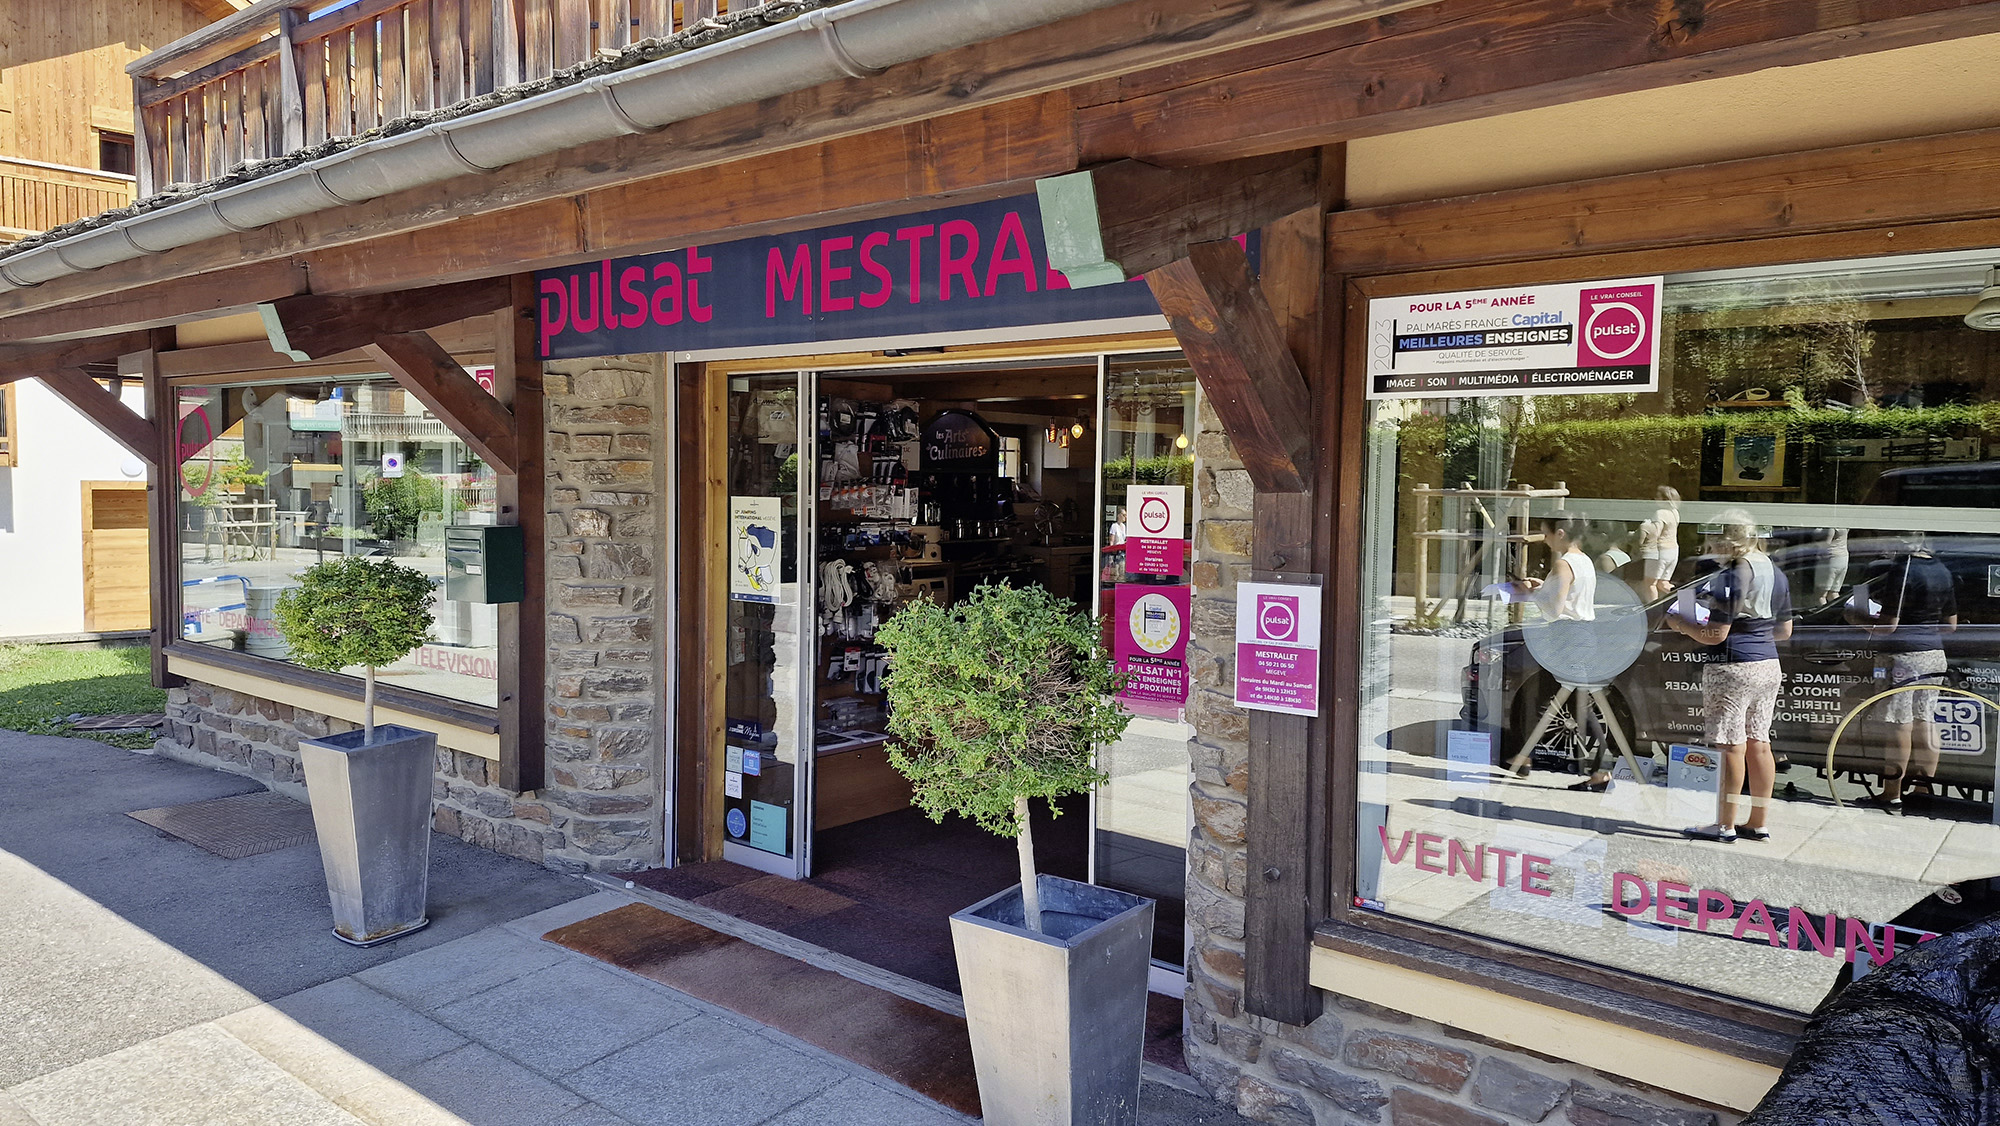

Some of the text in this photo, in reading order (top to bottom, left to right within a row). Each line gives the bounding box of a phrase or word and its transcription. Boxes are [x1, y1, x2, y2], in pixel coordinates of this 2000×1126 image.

[541, 246, 712, 356] pulsat
[1616, 291, 1643, 299] CONSEIL
[1409, 302, 1443, 313] POUR
[1446, 301, 1462, 310] LA
[1491, 293, 1535, 307] ANNÉE
[1406, 311, 1562, 332] PALMARÈS FRANCE Capital
[1593, 322, 1636, 339] pulsat
[1374, 319, 1391, 370] 2023
[1399, 329, 1568, 349] MEILLEURES ENSEIGNES
[1438, 348, 1523, 360] QUALITÉ DE SERVICE
[1386, 370, 1634, 388] IMAGE SON MULTIMÉDIA ÉLECTROMÉNAGER
[944, 429, 966, 443] Arts
[929, 444, 983, 461] Culinaires
[1144, 511, 1166, 519] pulsat
[1265, 616, 1290, 625] pulsat
[1255, 650, 1299, 661] MESTRALLET
[1127, 664, 1182, 678] PULSAT N°1
[1142, 676, 1182, 687] ENSEIGNES
[1269, 679, 1285, 687] Mardi
[1293, 682, 1313, 690] Samedi
[1139, 683, 1182, 695] PROXIMITÉ
[1378, 825, 1936, 967] VENTE DEPANN
